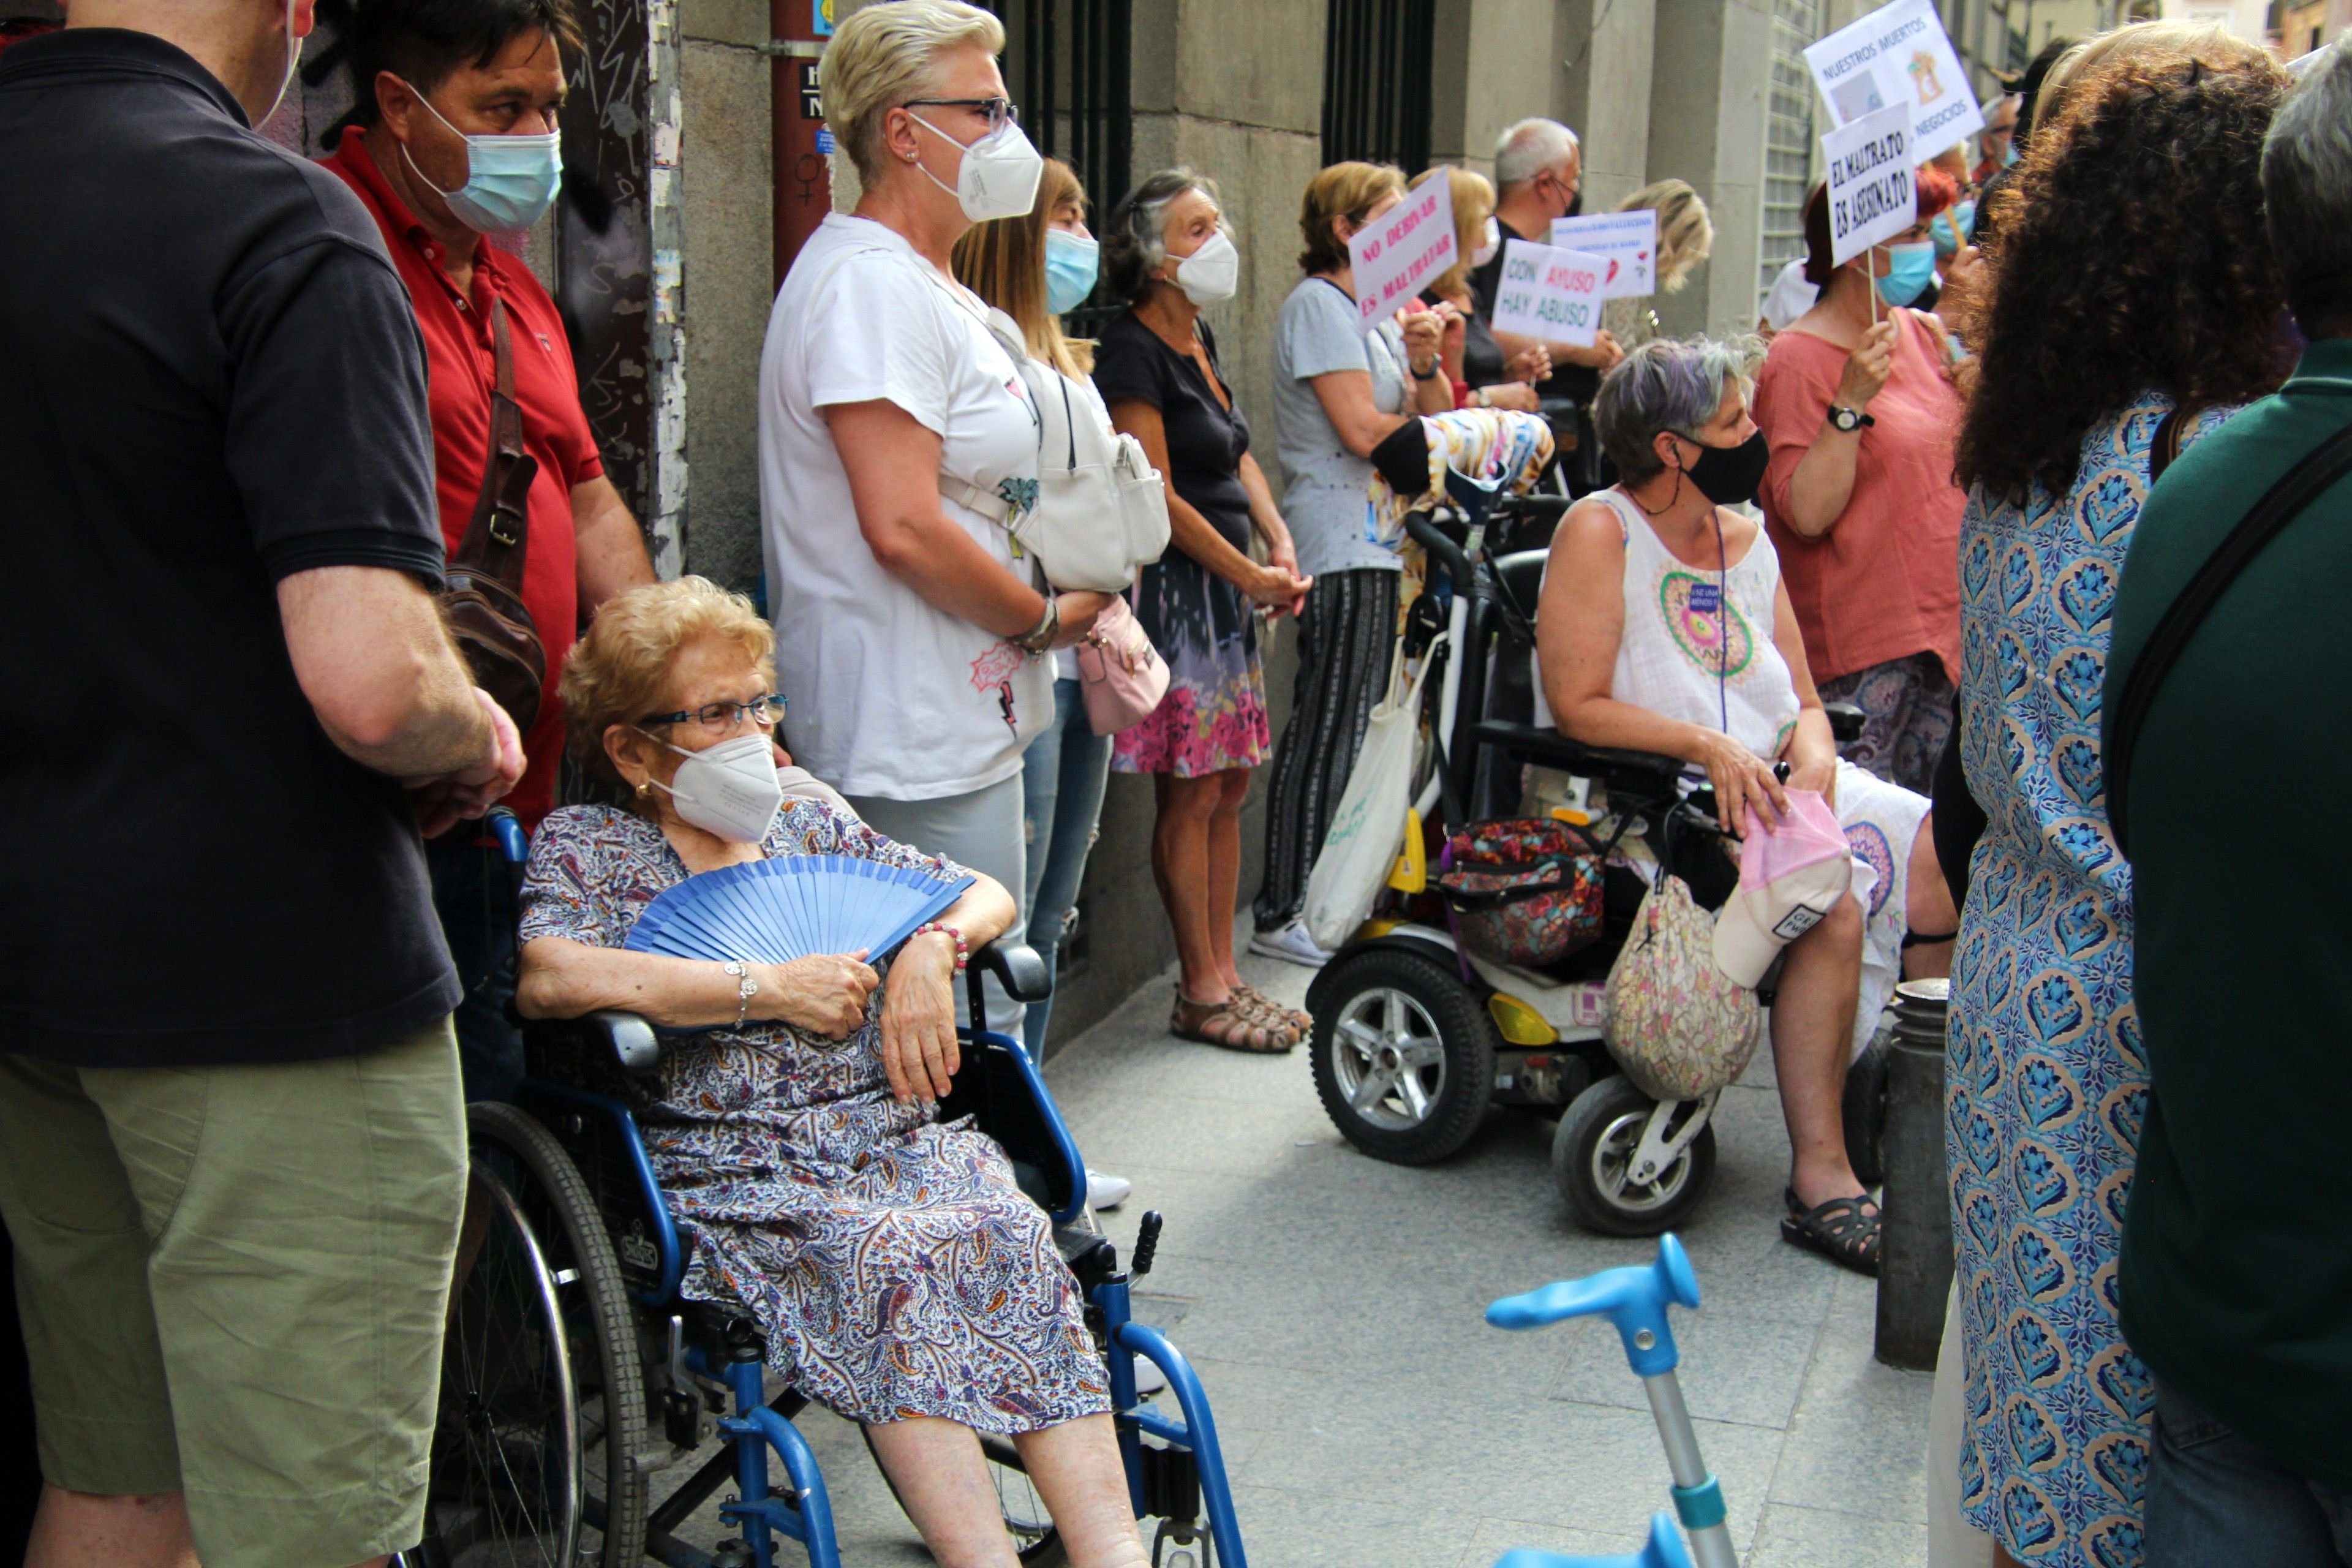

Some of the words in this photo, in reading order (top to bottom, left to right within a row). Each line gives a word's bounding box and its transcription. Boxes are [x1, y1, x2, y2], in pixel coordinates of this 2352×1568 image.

[1822, 42, 1877, 81] NUESTROS
[1878, 17, 1927, 51] MUERTOS
[1915, 99, 1969, 137] NEGOCIOS
[1832, 159, 1845, 189] EL
[1845, 131, 1904, 181] MALTRATO
[1362, 239, 1382, 264] NO
[1385, 195, 1437, 247] DERIVAR
[1835, 199, 1849, 239] ES
[1851, 170, 1908, 231] ASESINATO
[1362, 293, 1377, 317] ES
[1383, 233, 1451, 300] MALTRATAR
[1507, 257, 1537, 283] CON
[1544, 265, 1596, 295] AYUSO
[1501, 290, 1531, 316] HAY
[1534, 296, 1589, 328] ABUSO
